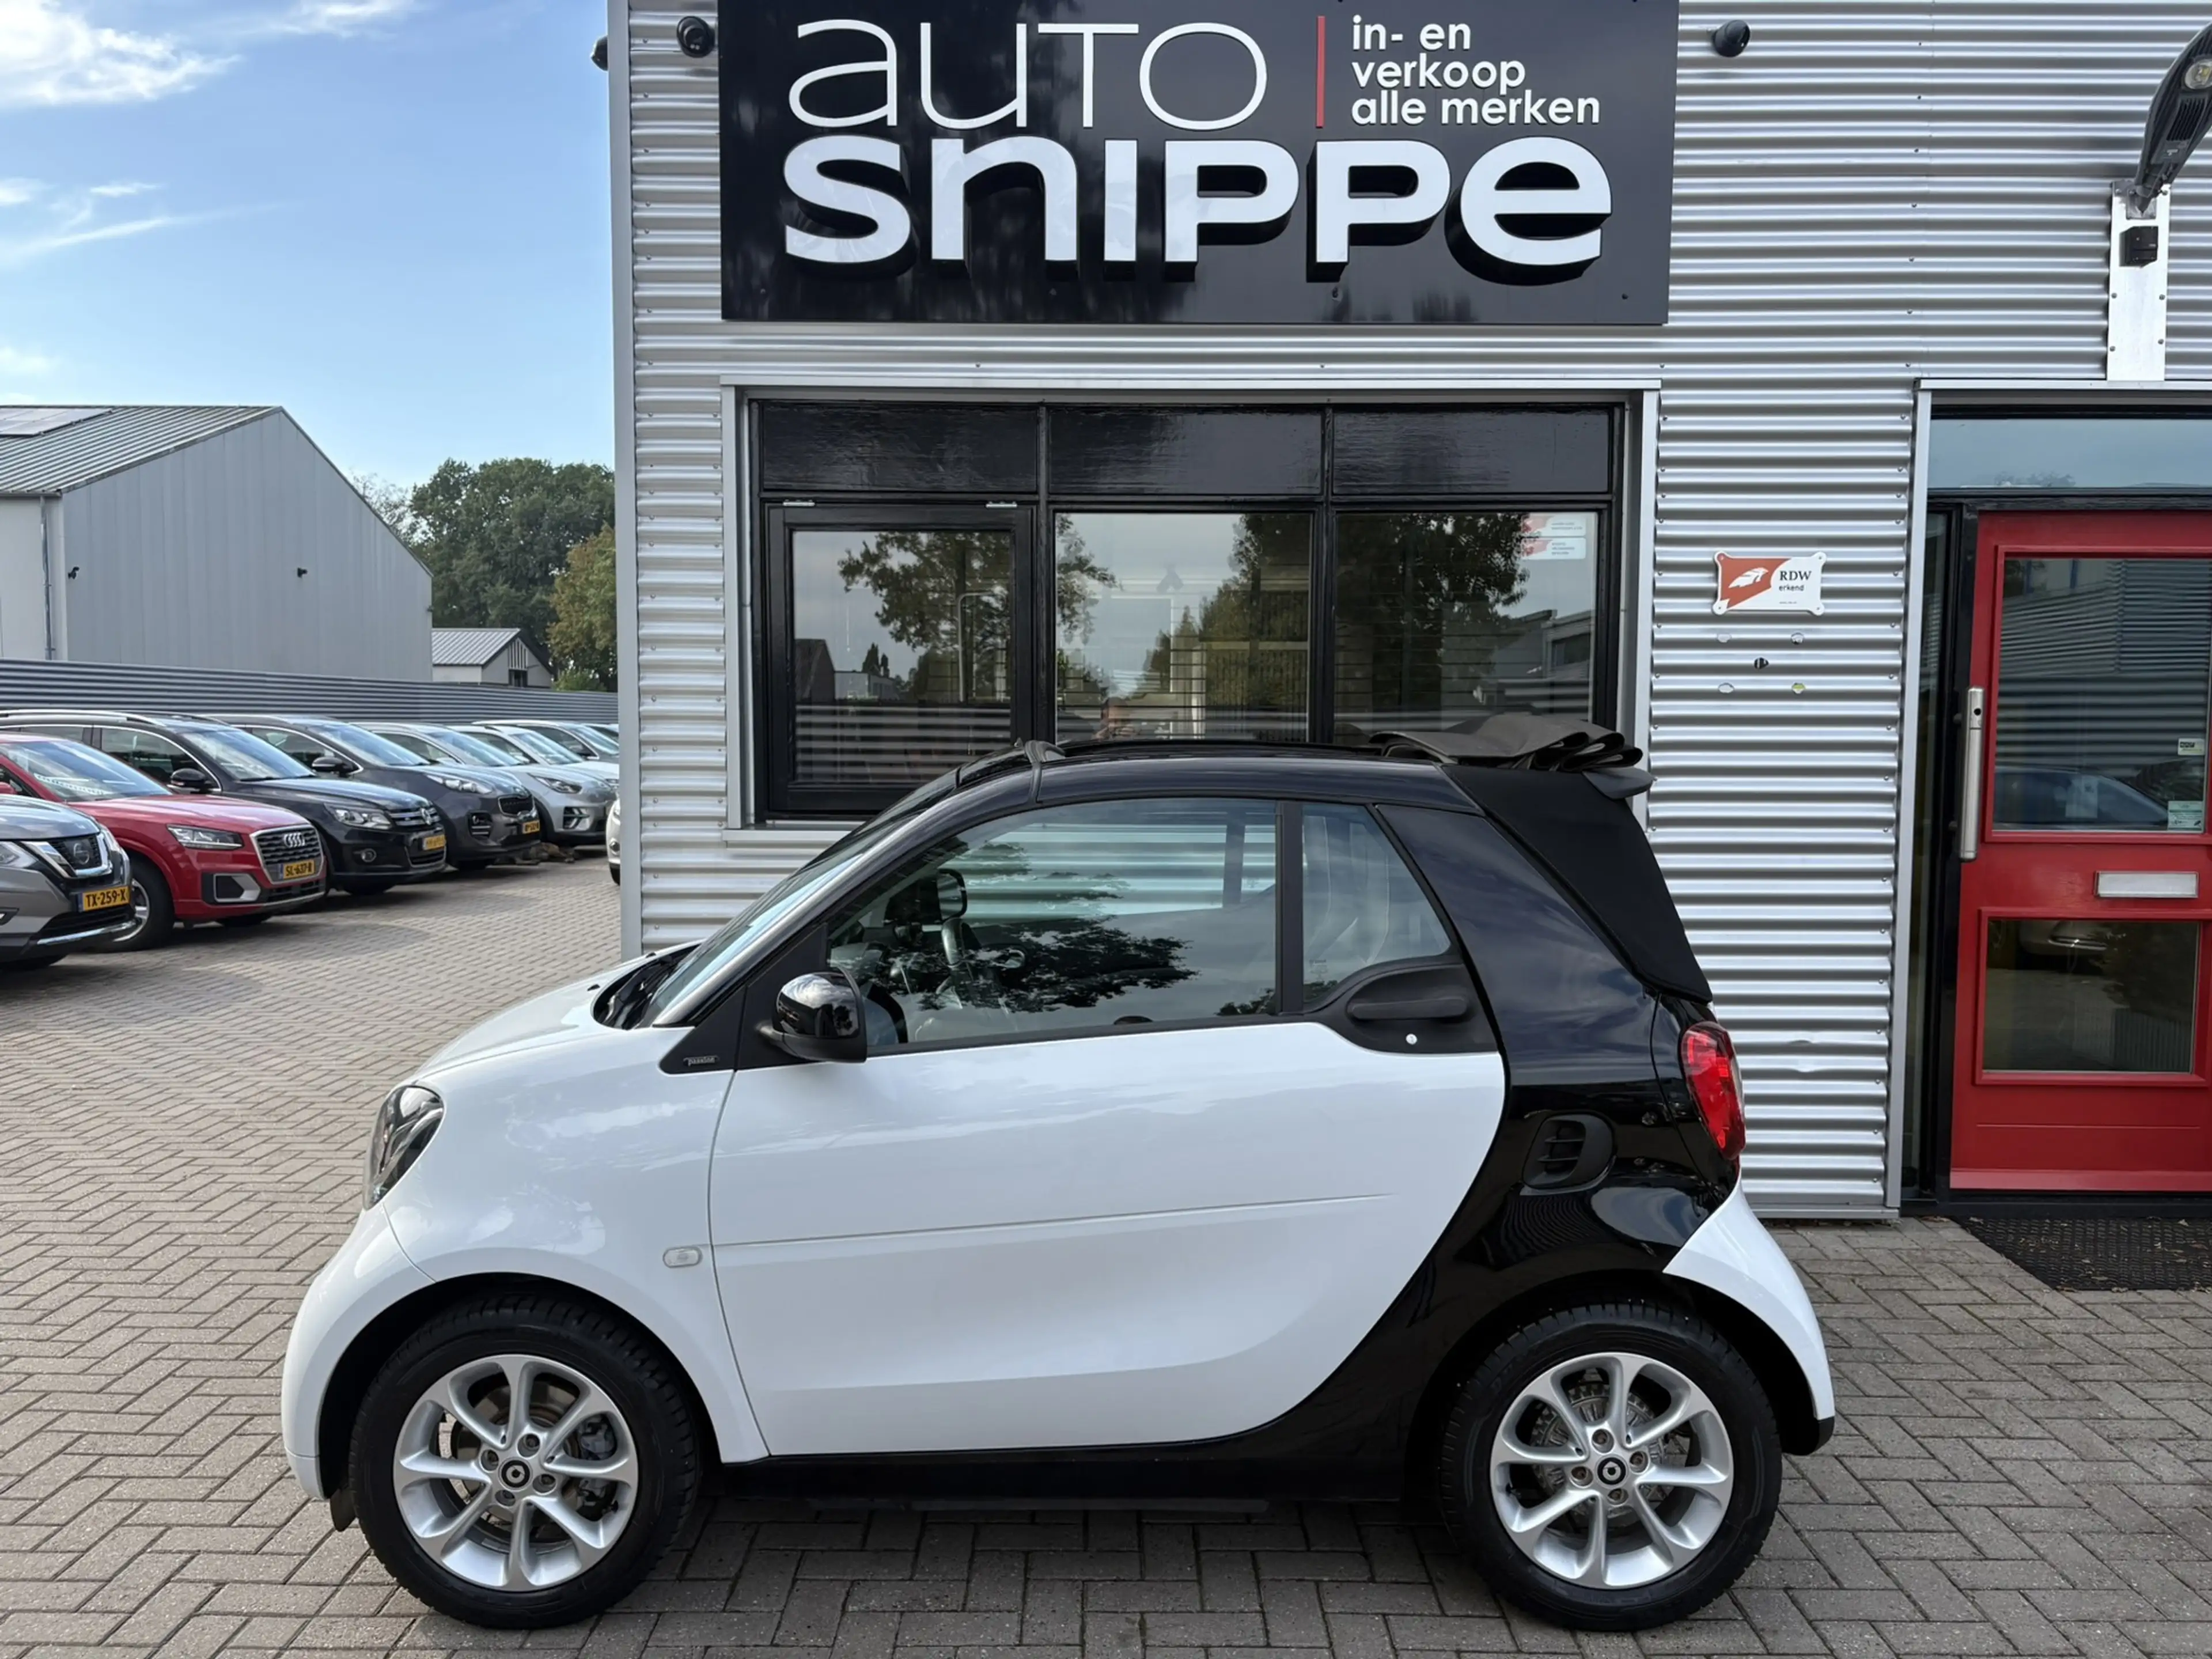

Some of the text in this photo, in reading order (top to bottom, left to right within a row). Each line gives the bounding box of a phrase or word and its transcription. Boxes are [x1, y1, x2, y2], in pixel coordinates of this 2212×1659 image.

[1353, 15, 1471, 50] in- en
[1352, 53, 1525, 94] verkoop
[1352, 89, 1600, 124] alle merken
[1779, 570, 1812, 581] RDW
[1779, 584, 1804, 592] erkend
[85, 889, 127, 907] TX-259-X
